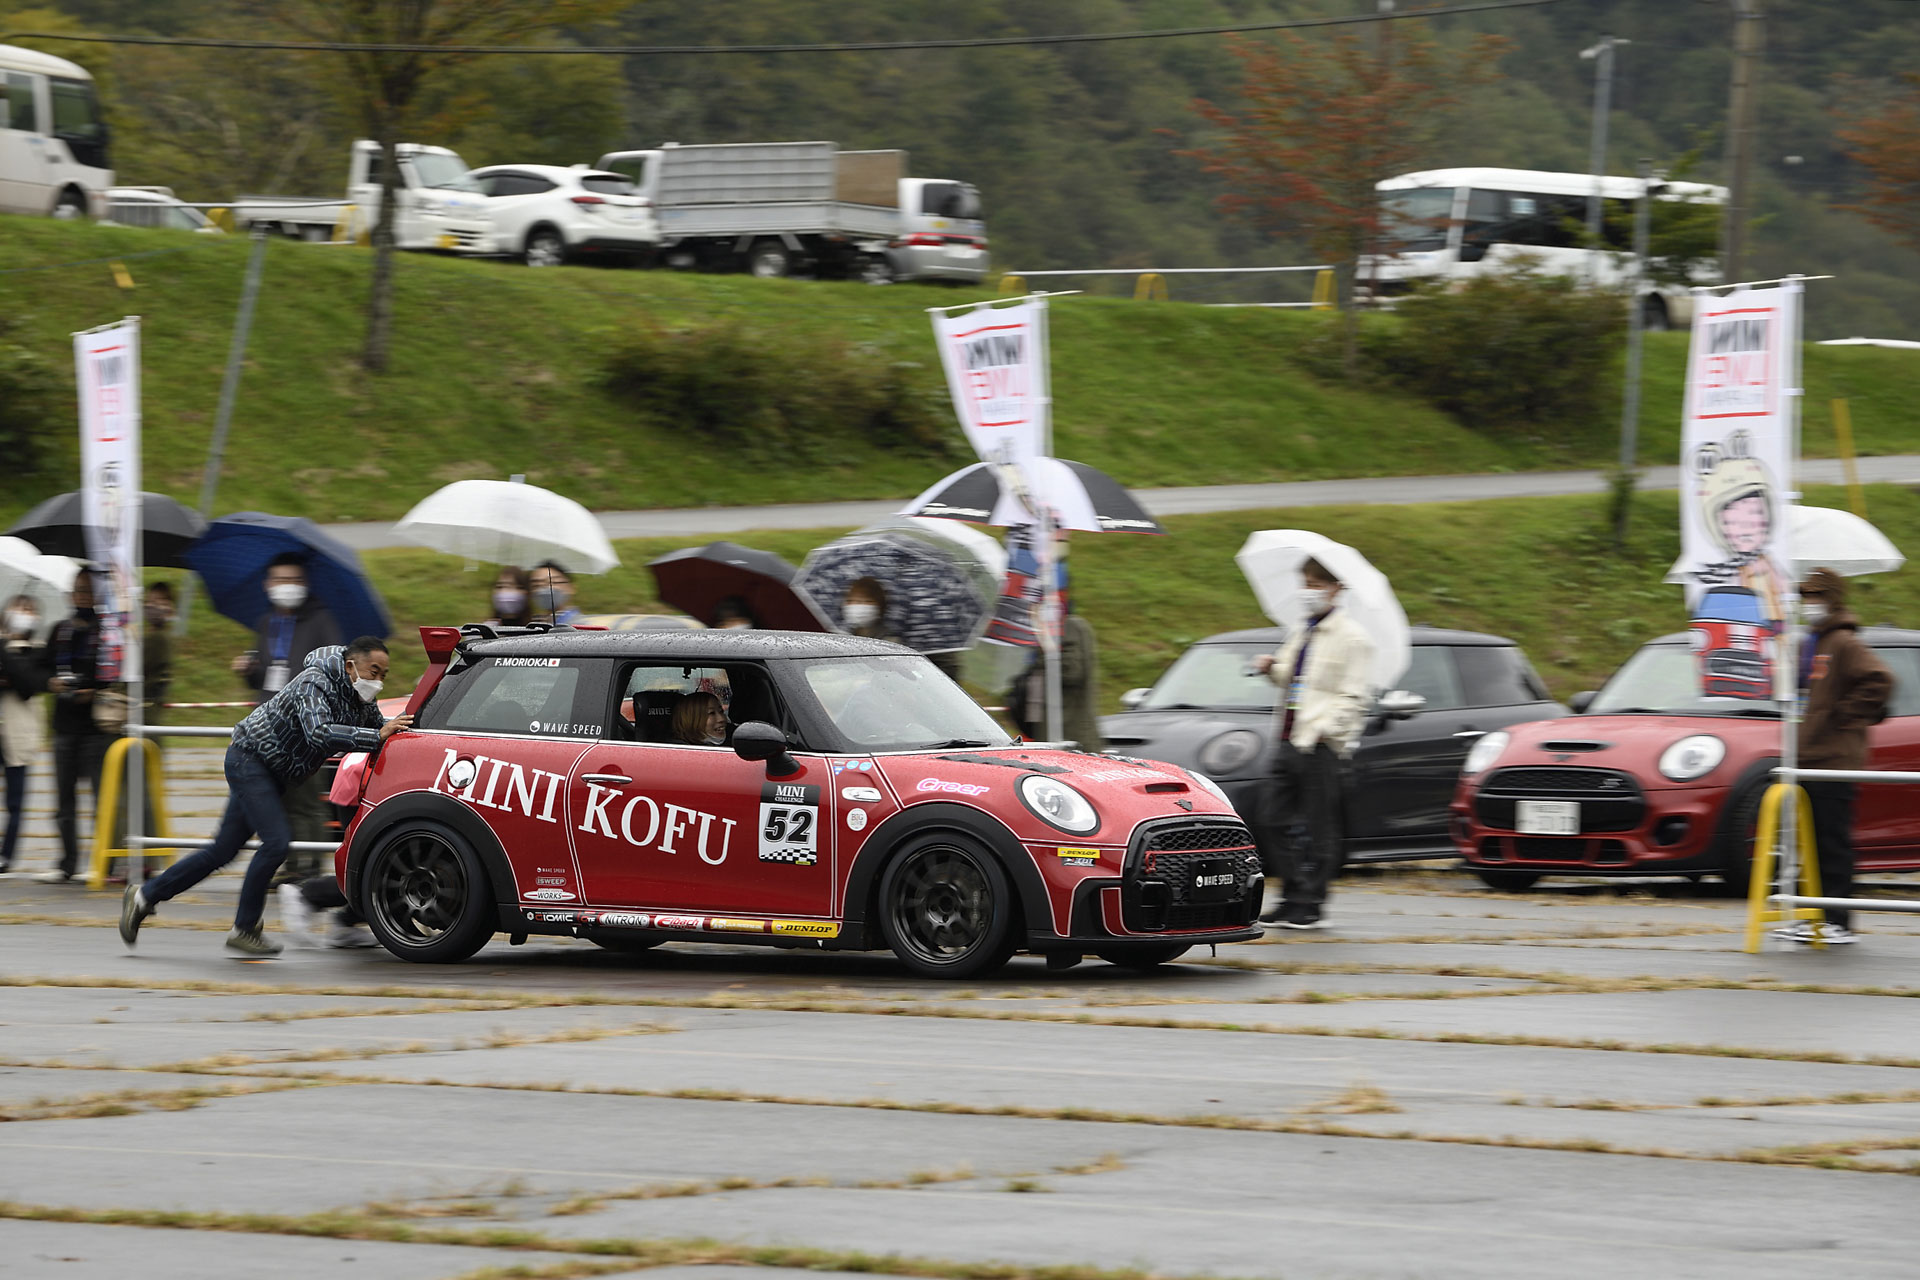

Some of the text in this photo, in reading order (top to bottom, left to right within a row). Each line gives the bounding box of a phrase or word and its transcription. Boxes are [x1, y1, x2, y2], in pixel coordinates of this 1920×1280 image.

[494, 657, 549, 667] F.MORIOKA
[543, 722, 602, 736] WAVE SPEED
[775, 785, 807, 798] MINI
[917, 777, 990, 796] Creer
[428, 748, 737, 866] MINI KOFU
[763, 807, 815, 845] 52
[1204, 874, 1234, 886] WAVE SPEED
[537, 892, 562, 900] WORKS
[605, 914, 642, 926] NITRON
[657, 916, 700, 928] Eibach
[784, 924, 833, 933] DUNLOP
